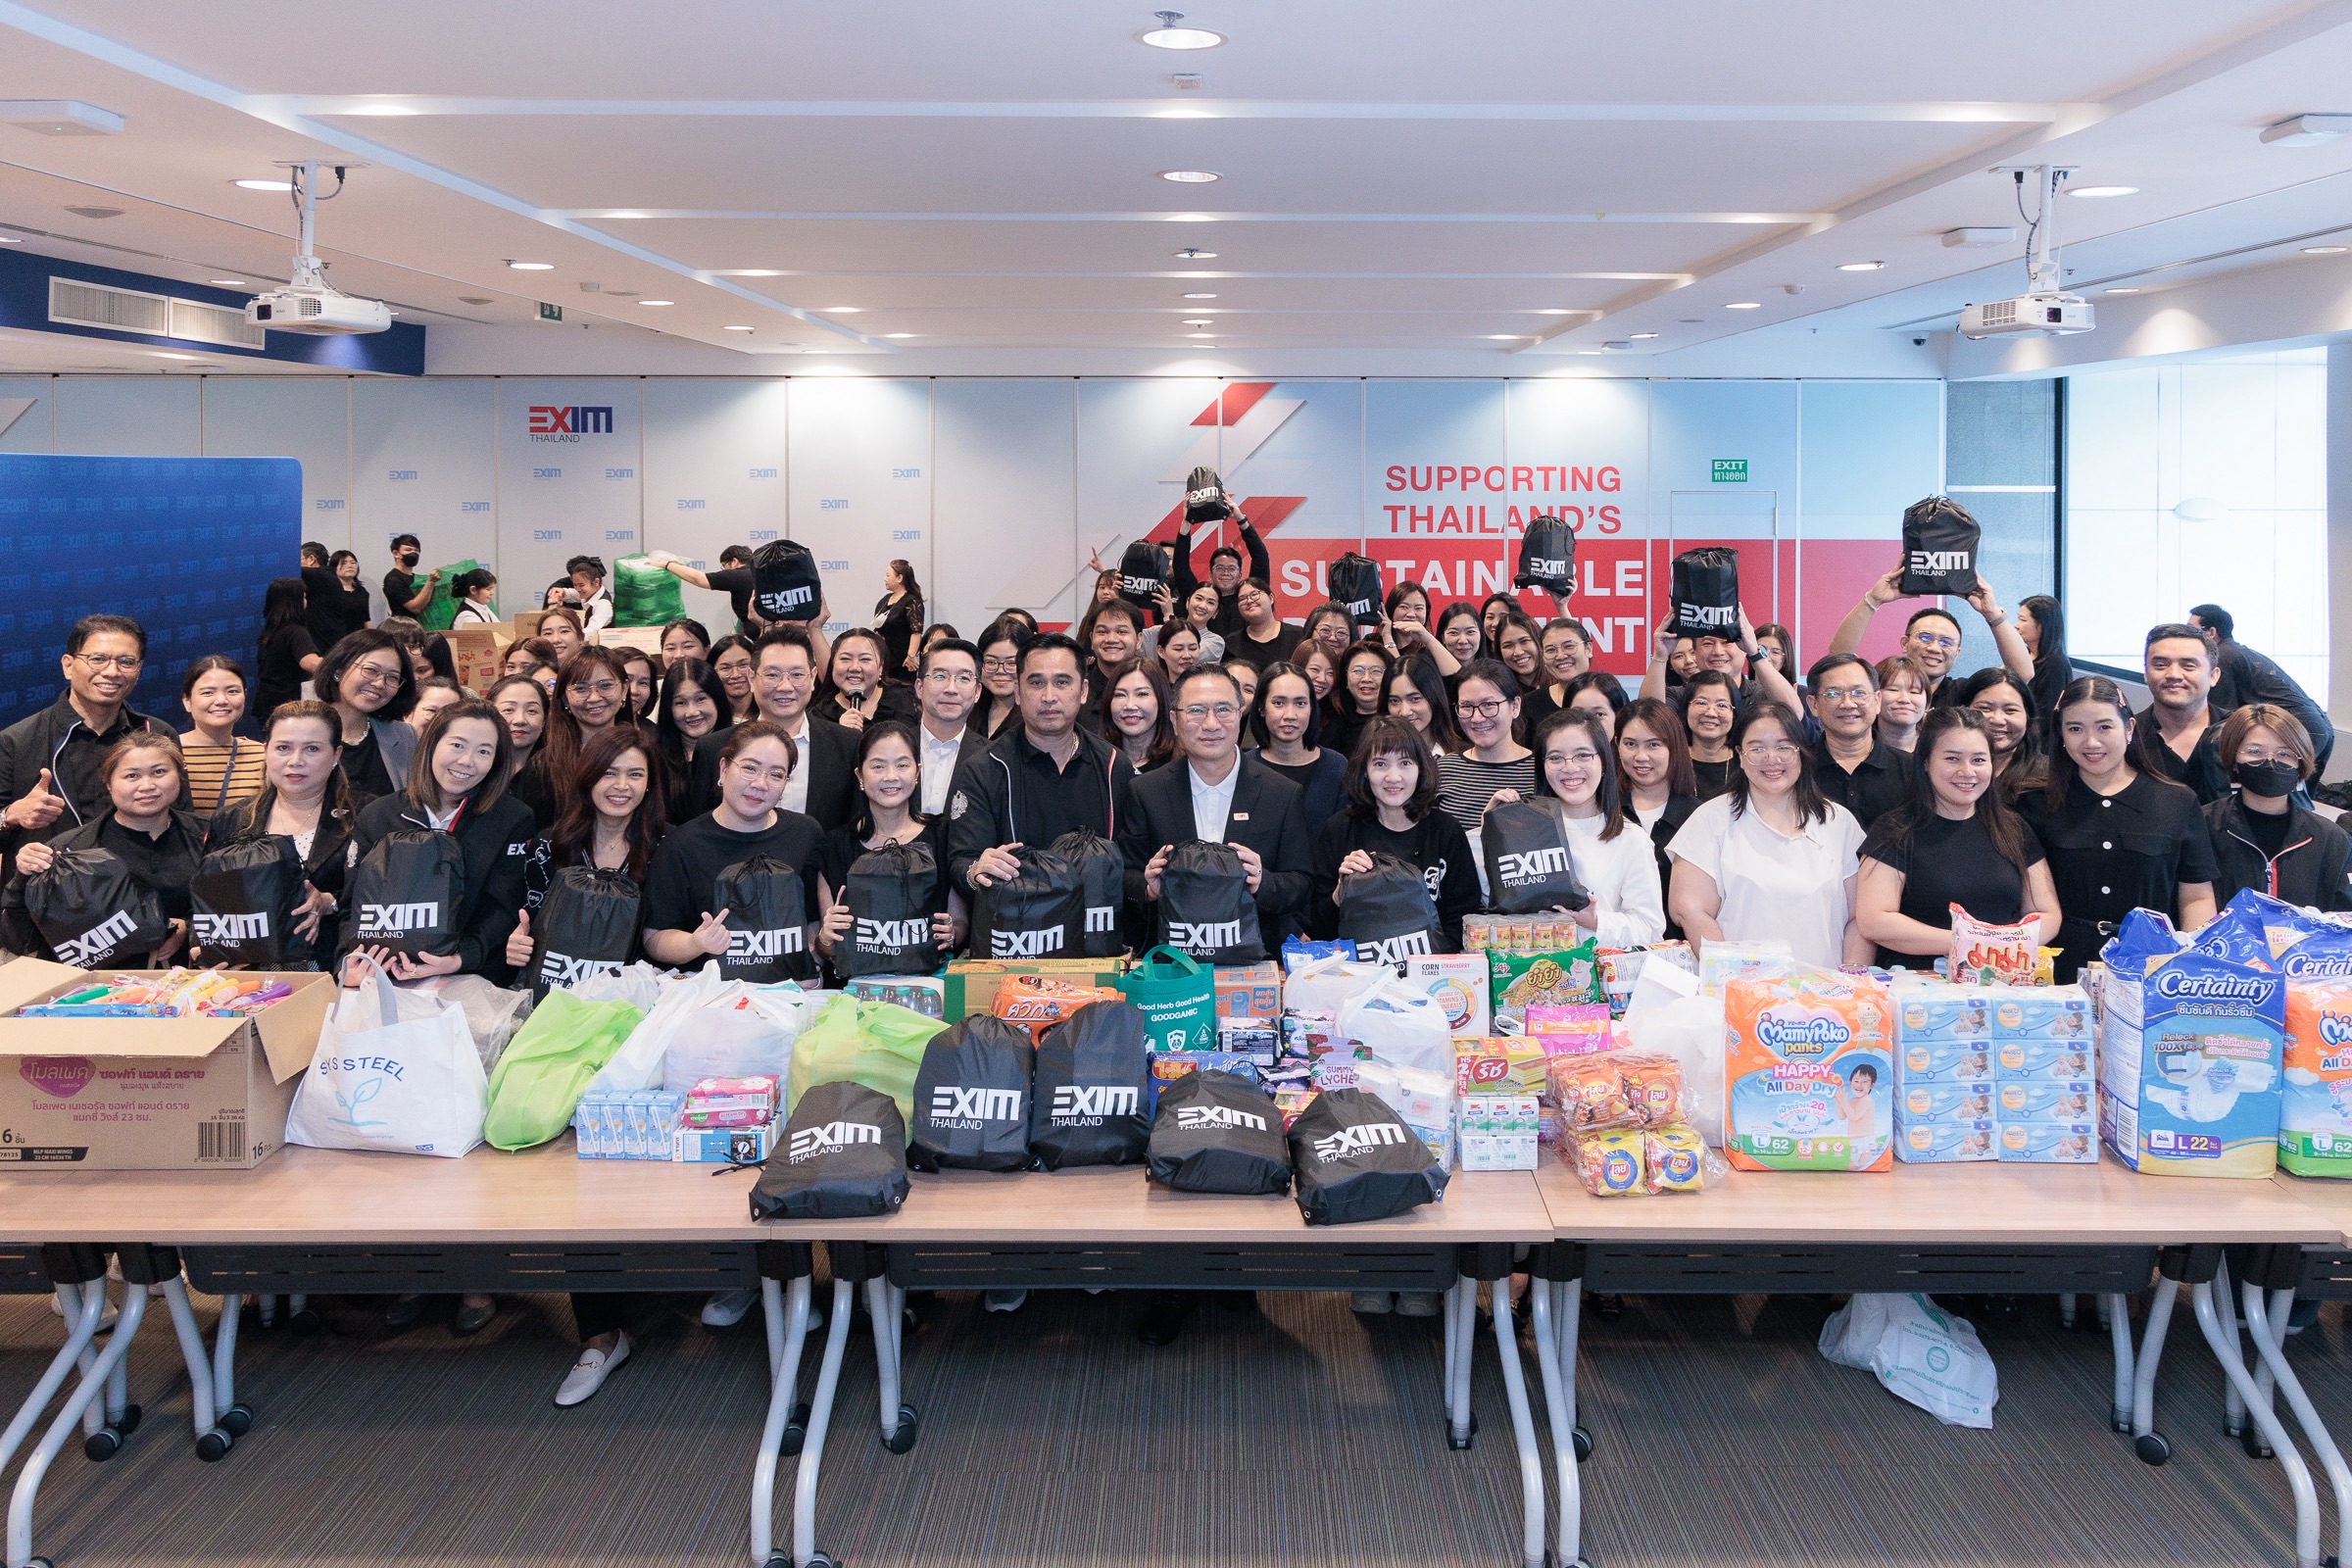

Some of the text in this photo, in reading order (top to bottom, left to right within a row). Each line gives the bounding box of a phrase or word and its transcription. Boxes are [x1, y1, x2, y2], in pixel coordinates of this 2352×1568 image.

[529, 406, 612, 433] EXIM
[530, 434, 580, 443] THAILAND
[1715, 461, 1744, 469] EXIT
[390, 470, 417, 480] EXIM
[534, 468, 562, 477] EXIM
[606, 468, 633, 477] EXIM
[750, 468, 777, 478] EXIM
[893, 468, 920, 478] EXIM
[1386, 466, 1621, 492] SUPPORTING
[1714, 471, 1745, 481] ทางออก
[1190, 486, 1218, 501] EXIM
[317, 500, 344, 509] EXIM
[462, 502, 490, 512] EXIM
[677, 499, 705, 509] EXIM
[821, 499, 849, 509] EXIM
[534, 530, 562, 540] EXIM
[606, 530, 633, 540] EXIM
[750, 530, 777, 540] EXIM
[893, 530, 920, 540] EXIM
[821, 561, 849, 570] EXIM
[1531, 558, 1565, 574] EXIM
[1911, 551, 1969, 570] EXIM
[1281, 560, 1643, 597] STAINLE
[1531, 570, 1554, 579] THAILAND
[1124, 575, 1157, 592] EXIM
[760, 586, 812, 609] EXIM
[772, 604, 795, 613] ILAND
[1680, 603, 1734, 624] EXIM
[1680, 620, 1714, 630] THAILAND
[1498, 847, 1570, 880] EXIM
[1503, 874, 1546, 890] THAILAND
[359, 902, 438, 931] EXIM
[193, 911, 270, 939] EXIM
[856, 917, 929, 946] EXIM
[54, 909, 138, 964] EXIM
[357, 930, 404, 940] THAILAND
[991, 924, 1063, 956] EXIM
[1169, 918, 1241, 948] EXIM
[200, 937, 241, 949] THAAND
[726, 926, 802, 956] EXIM
[1357, 930, 1431, 964] EXIM
[856, 943, 901, 956] THAILAND
[1181, 947, 1216, 956] AILAND
[74, 948, 115, 969] AILAND
[726, 956, 773, 965] THAILAND
[540, 974, 576, 990] THAILA
[2159, 970, 2275, 1004] Certainty
[1137, 1002, 1155, 1011] Good
[1156, 1002, 1174, 1010] Herb
[1175, 999, 1193, 1007] Good
[1193, 993, 1210, 1005] Health
[1441, 1002, 1462, 1010] INERALS
[1151, 1007, 1199, 1022] GOODGANIC
[1757, 1012, 1849, 1046] MamyPoko
[1784, 1042, 1824, 1056] pants
[319, 1056, 405, 1082] SYS STEEL
[1326, 1065, 1354, 1074] GUMMY
[2322, 1057, 2339, 1069] All
[1774, 1063, 1833, 1079] HAPPY
[1321, 1074, 1354, 1086] LYCHE
[1767, 1081, 1837, 1098] All Day Dry
[32, 1100, 67, 1111] โมลเพด
[138, 1099, 164, 1110] แอนด์
[932, 1086, 1022, 1120] EXIM
[1051, 1086, 1139, 1116] EXIM
[122, 1112, 133, 1122] 23
[930, 1117, 983, 1131] THAILAND
[1051, 1116, 1103, 1127] THAILAND
[1178, 1105, 1267, 1132] EXIM
[1179, 1120, 1235, 1131] THAILAND
[2, 1129, 13, 1144] 6
[790, 1121, 881, 1157] EXIM
[1313, 1123, 1407, 1157] EXIM
[1757, 1137, 1764, 1147] L
[2178, 1136, 2209, 1151] L 22
[252, 1143, 264, 1157] 16
[1772, 1139, 1789, 1150] 62
[2318, 1140, 2327, 1150] L
[2334, 1142, 2352, 1152] 62
[790, 1144, 844, 1165] THAILAND
[1318, 1146, 1374, 1164] THAILAND
